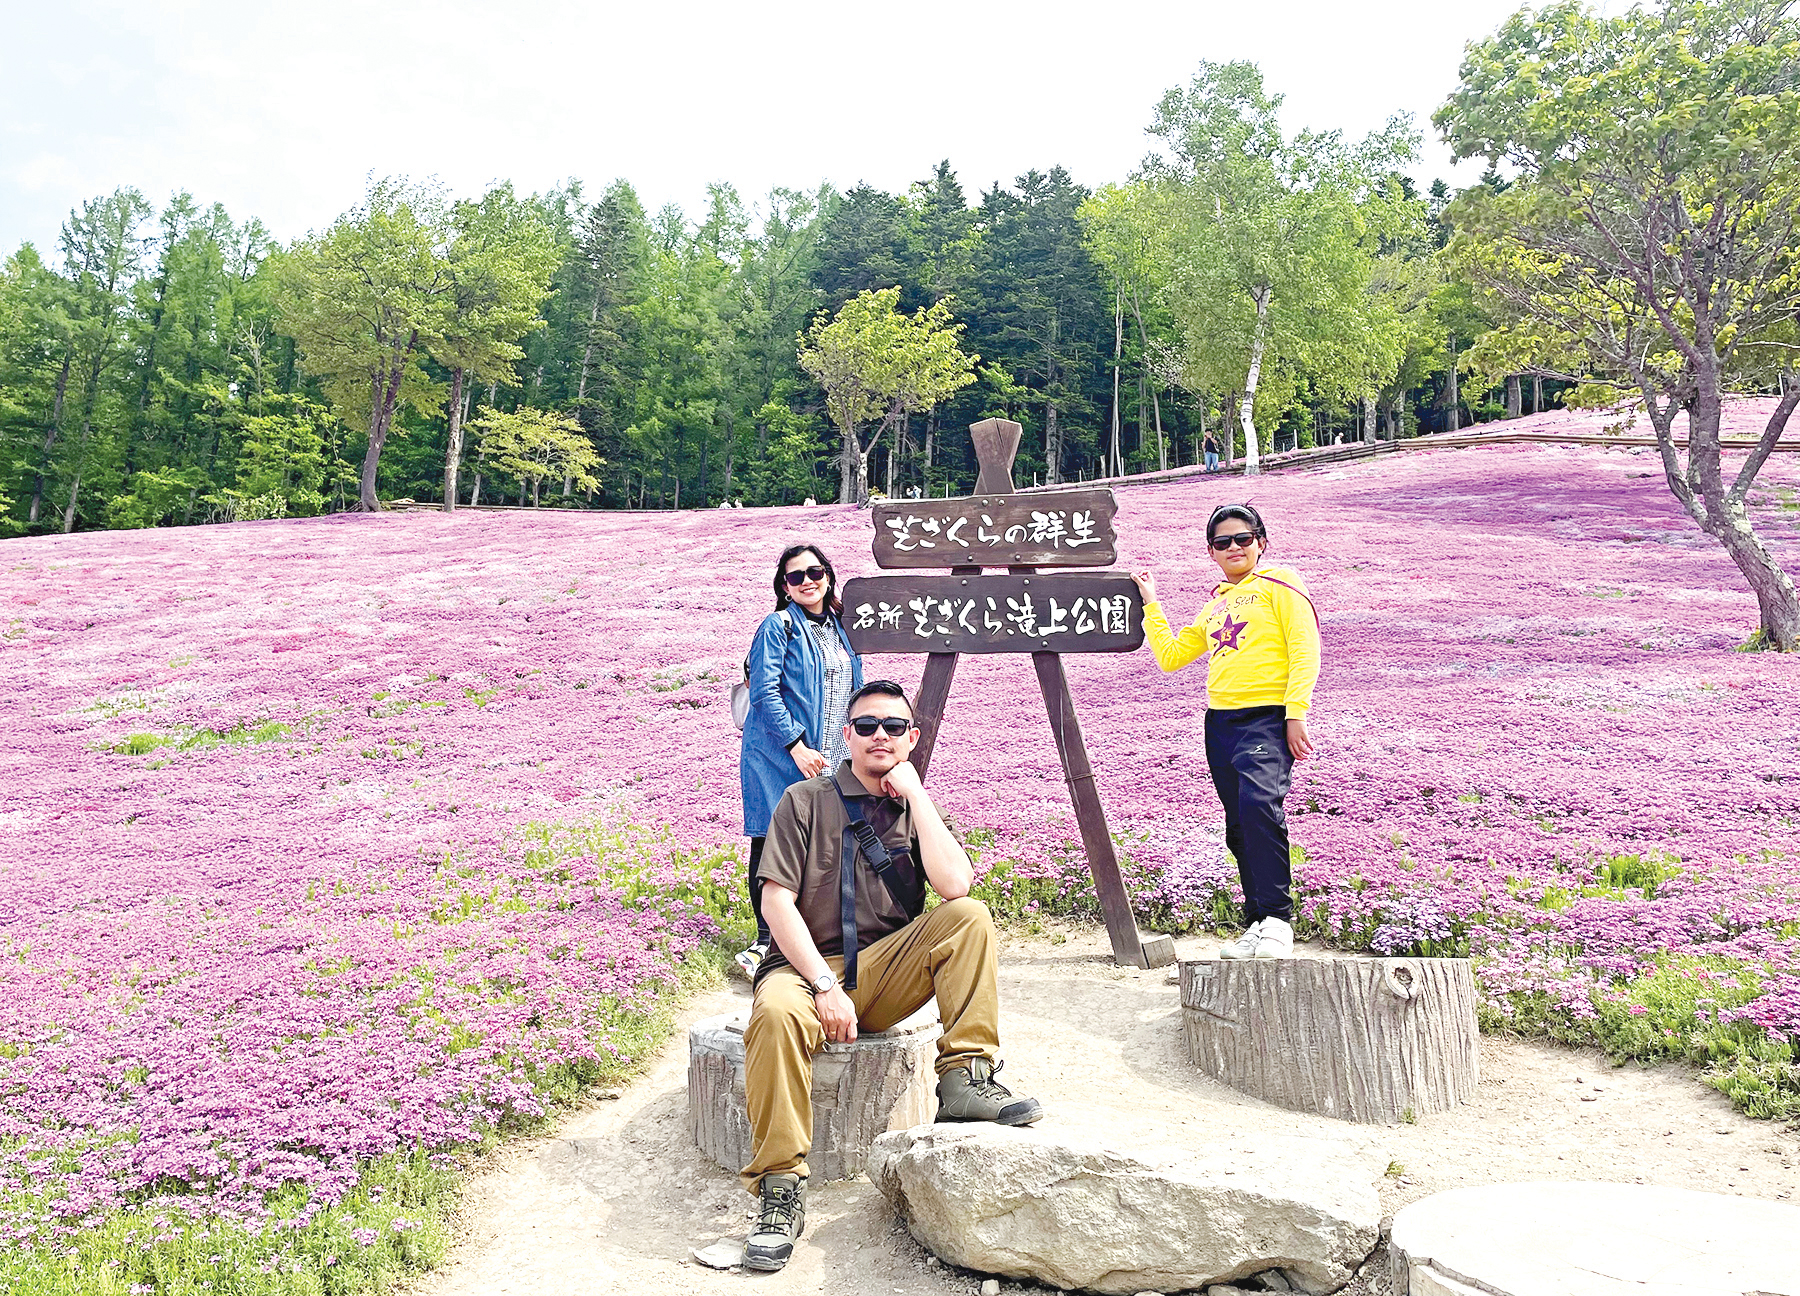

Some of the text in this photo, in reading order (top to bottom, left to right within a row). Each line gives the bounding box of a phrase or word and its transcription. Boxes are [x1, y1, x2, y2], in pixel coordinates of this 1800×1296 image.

[886, 510, 1102, 551] 芝ざくらの群生
